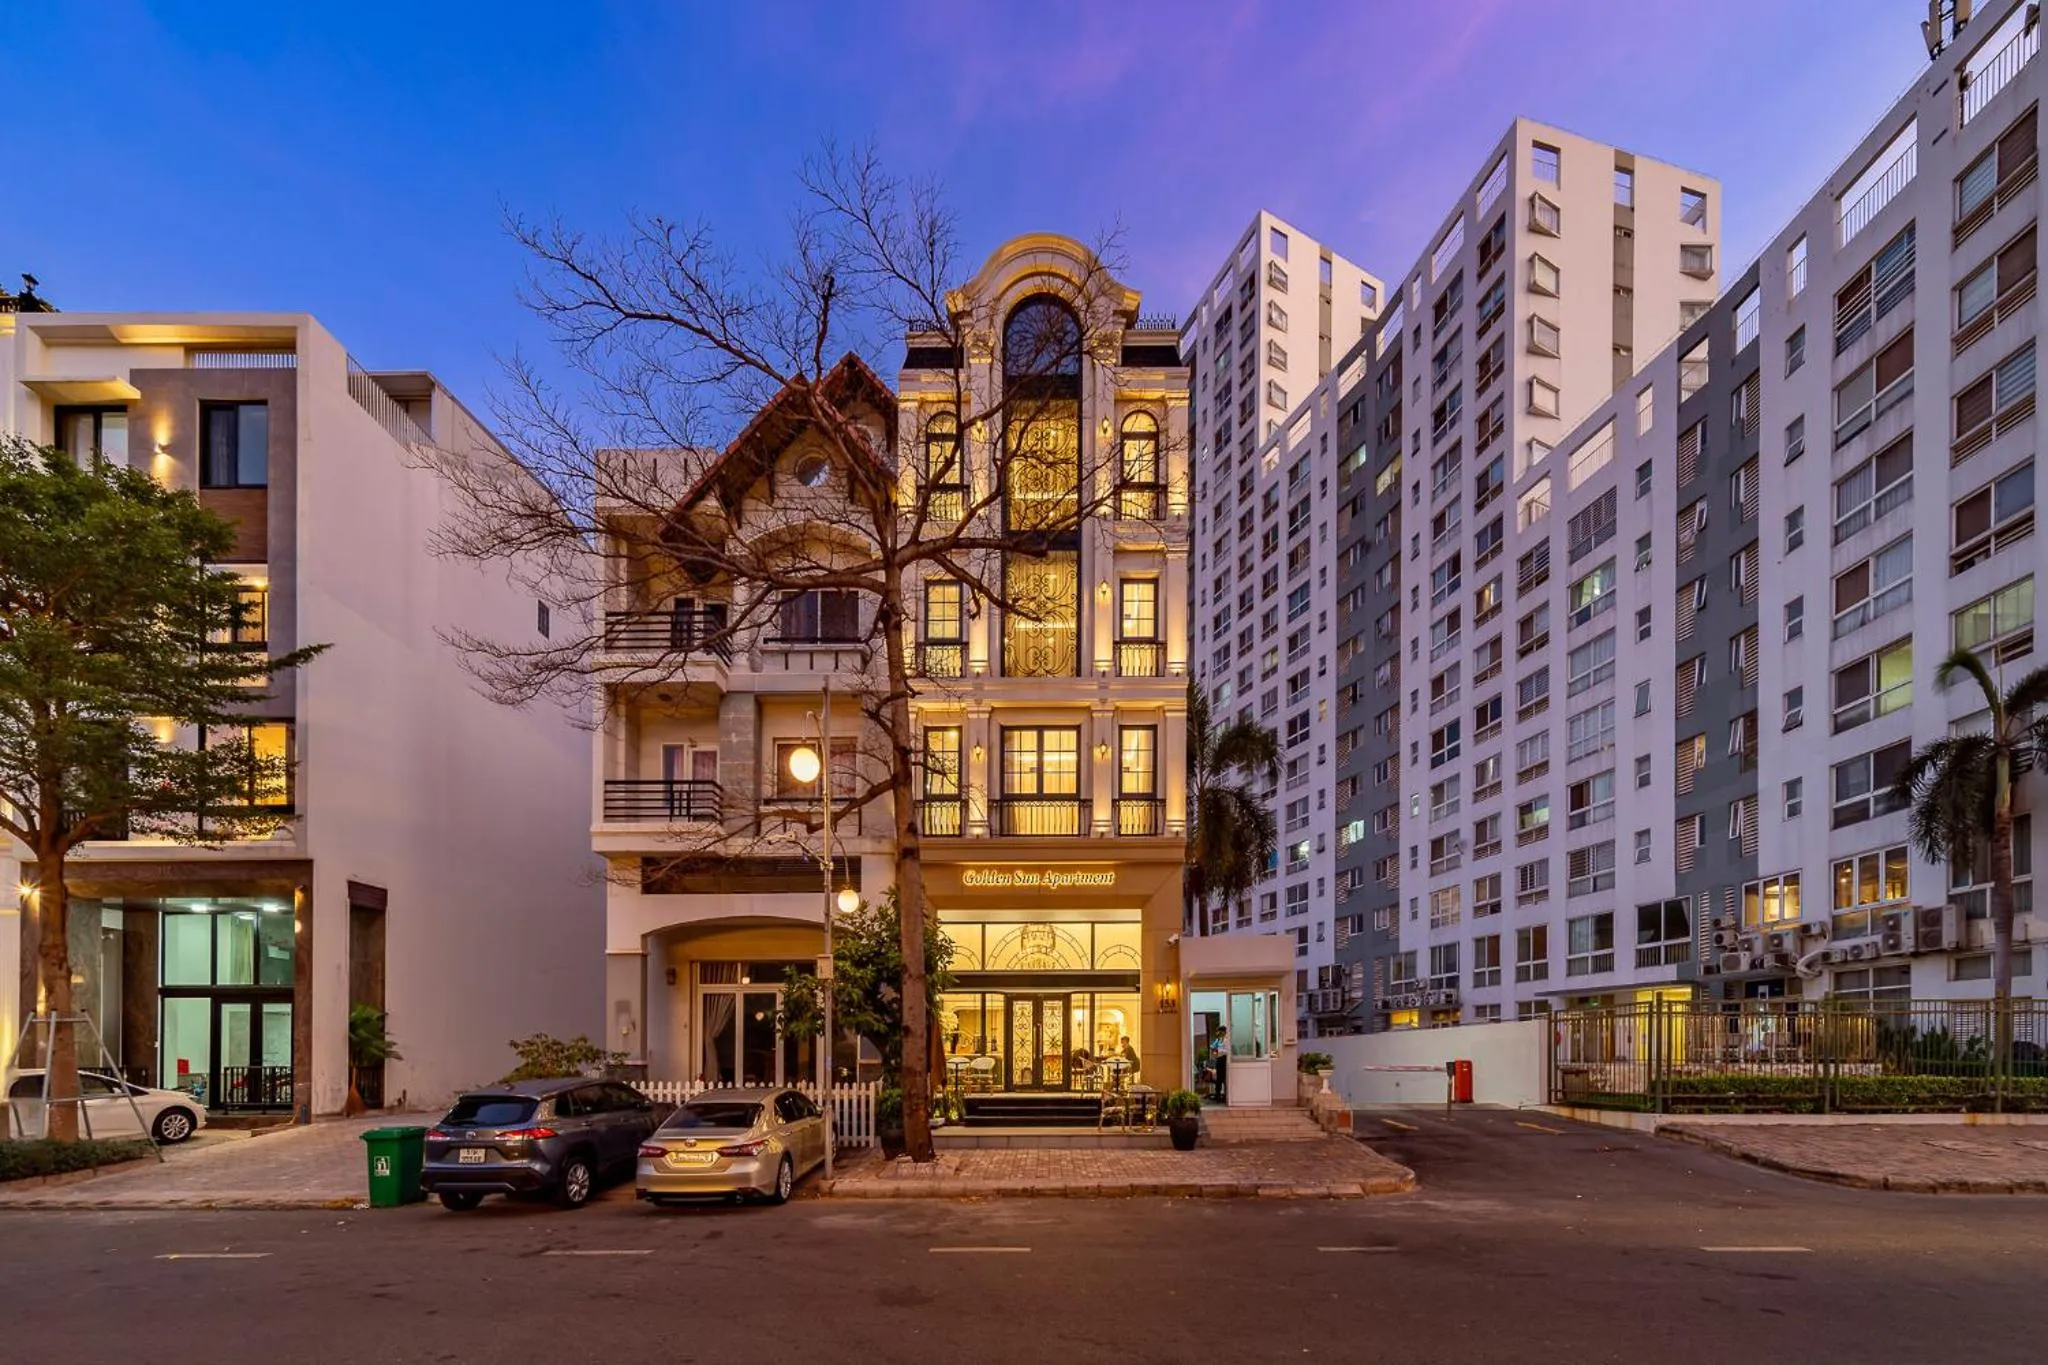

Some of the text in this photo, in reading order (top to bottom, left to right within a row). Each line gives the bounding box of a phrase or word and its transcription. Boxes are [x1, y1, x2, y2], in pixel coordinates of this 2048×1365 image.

[964, 870, 1115, 888] Golden Sun Apartment
